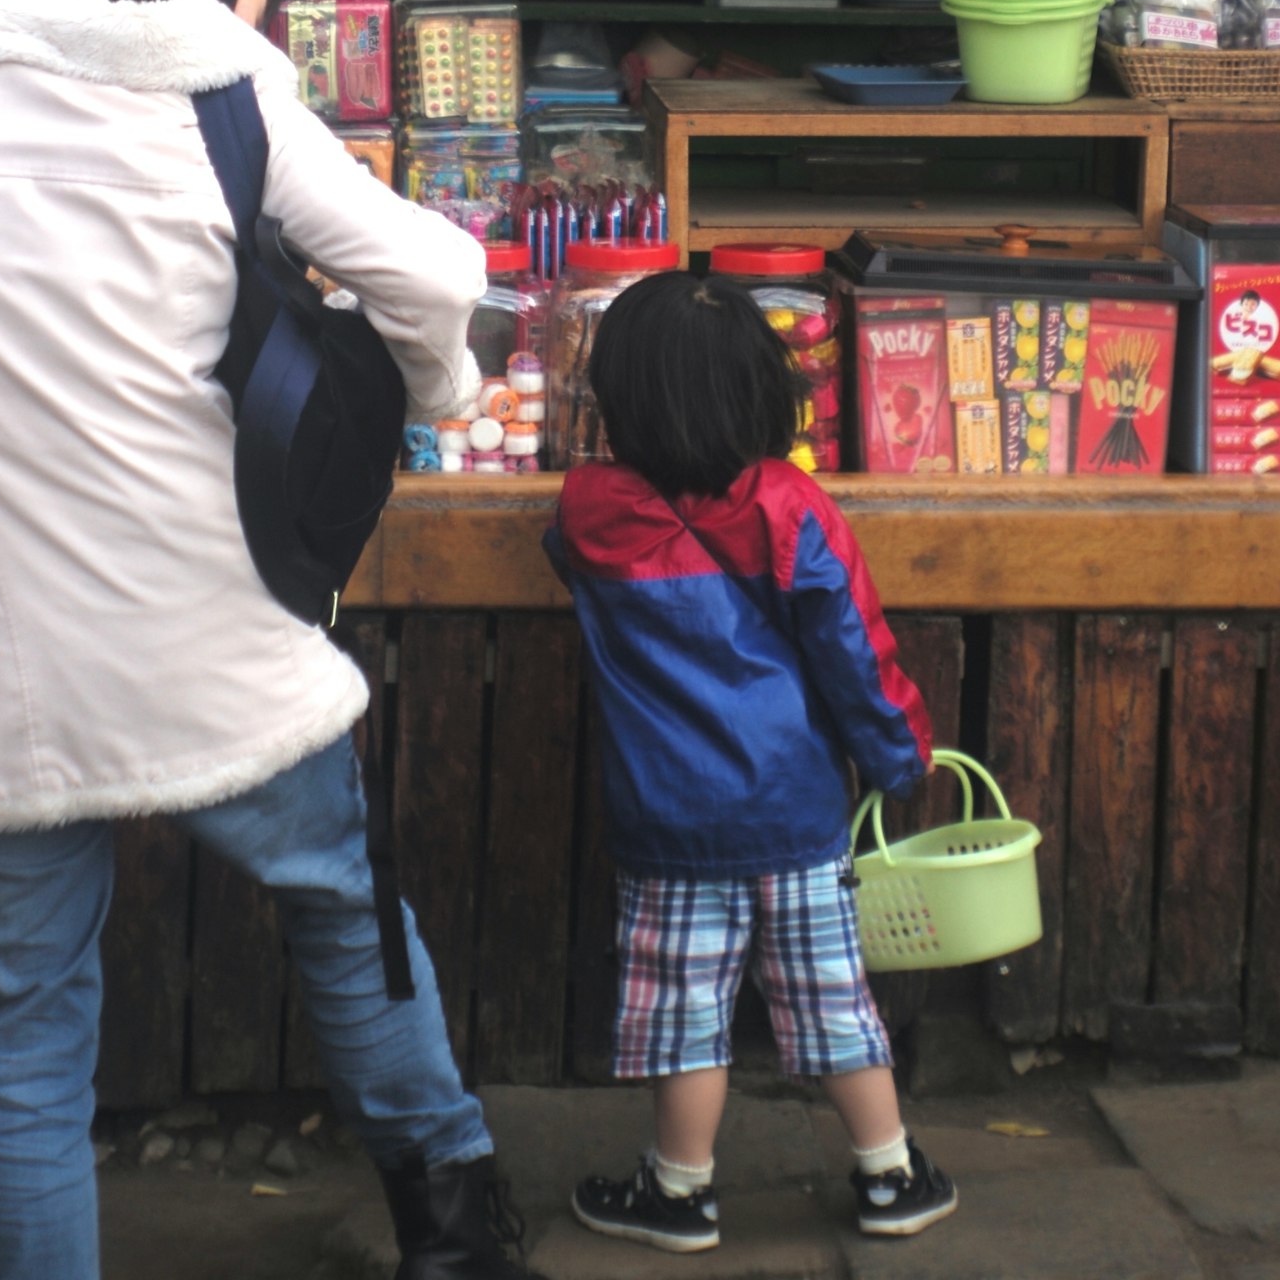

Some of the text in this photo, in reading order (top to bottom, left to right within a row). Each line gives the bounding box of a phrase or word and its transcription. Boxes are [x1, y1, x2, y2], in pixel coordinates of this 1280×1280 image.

[997, 310, 1010, 382] ボンタンアメ
[1045, 311, 1060, 382] ボンタンアメ
[1225, 312, 1273, 342] ビスコ
[1007, 402, 1020, 472] ボンタンアメ
